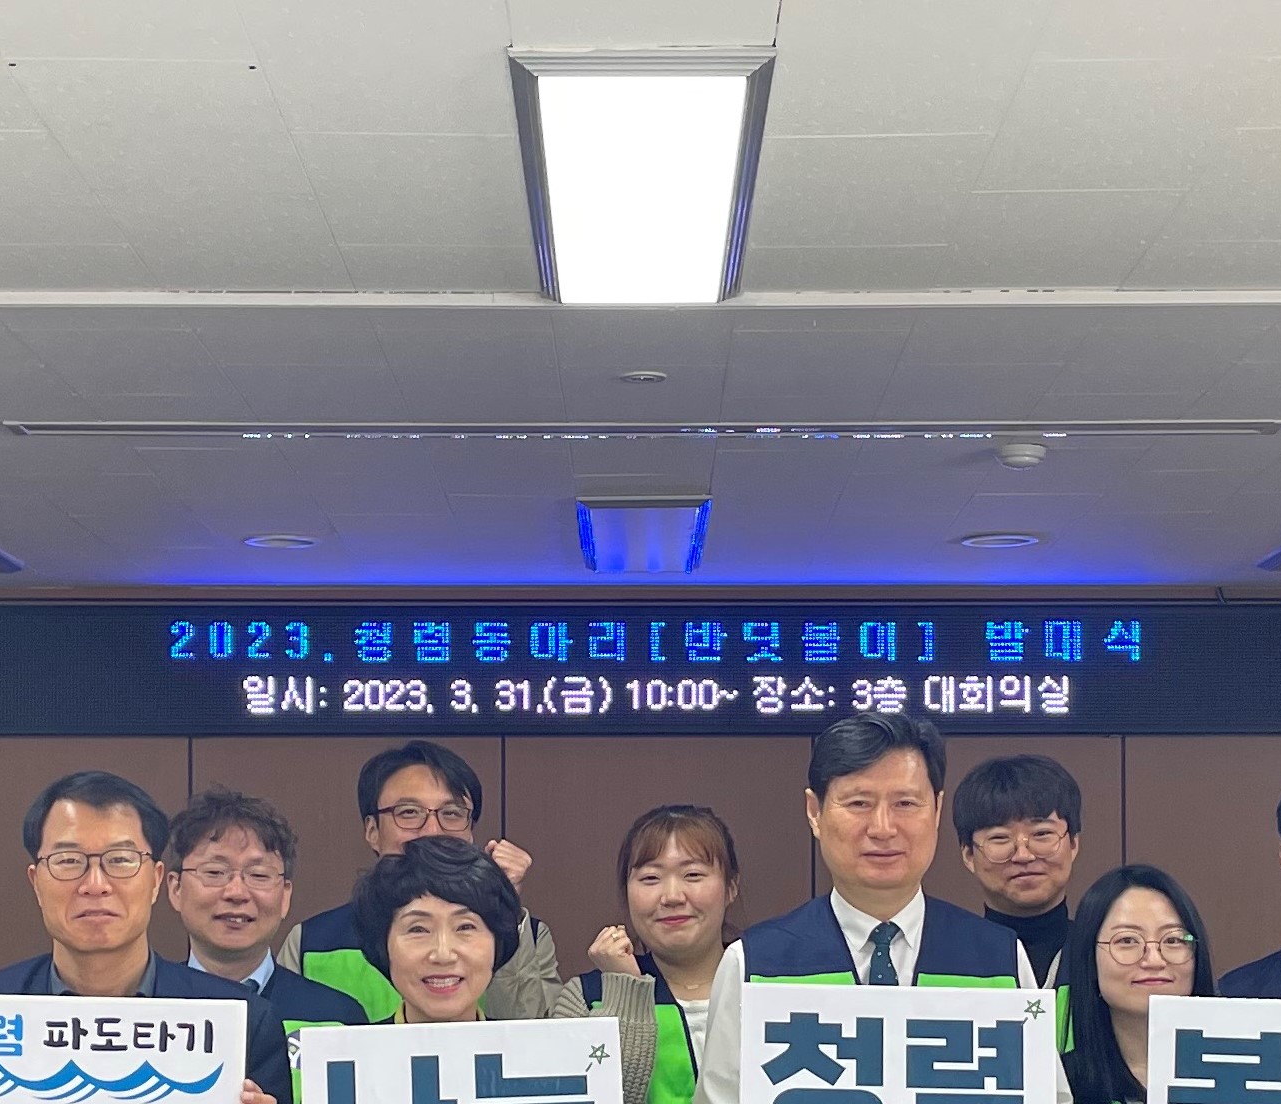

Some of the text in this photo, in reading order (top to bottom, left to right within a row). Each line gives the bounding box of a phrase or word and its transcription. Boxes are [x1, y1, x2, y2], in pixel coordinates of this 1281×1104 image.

[985, 620, 1142, 663] 발대식
[242, 675, 329, 716] 일시:
[625, 678, 739, 711] 10:00~
[752, 675, 836, 715] 장소:
[851, 675, 909, 714] 3층
[922, 674, 1070, 715] 대회의실
[43, 1017, 214, 1054] 파도타기
